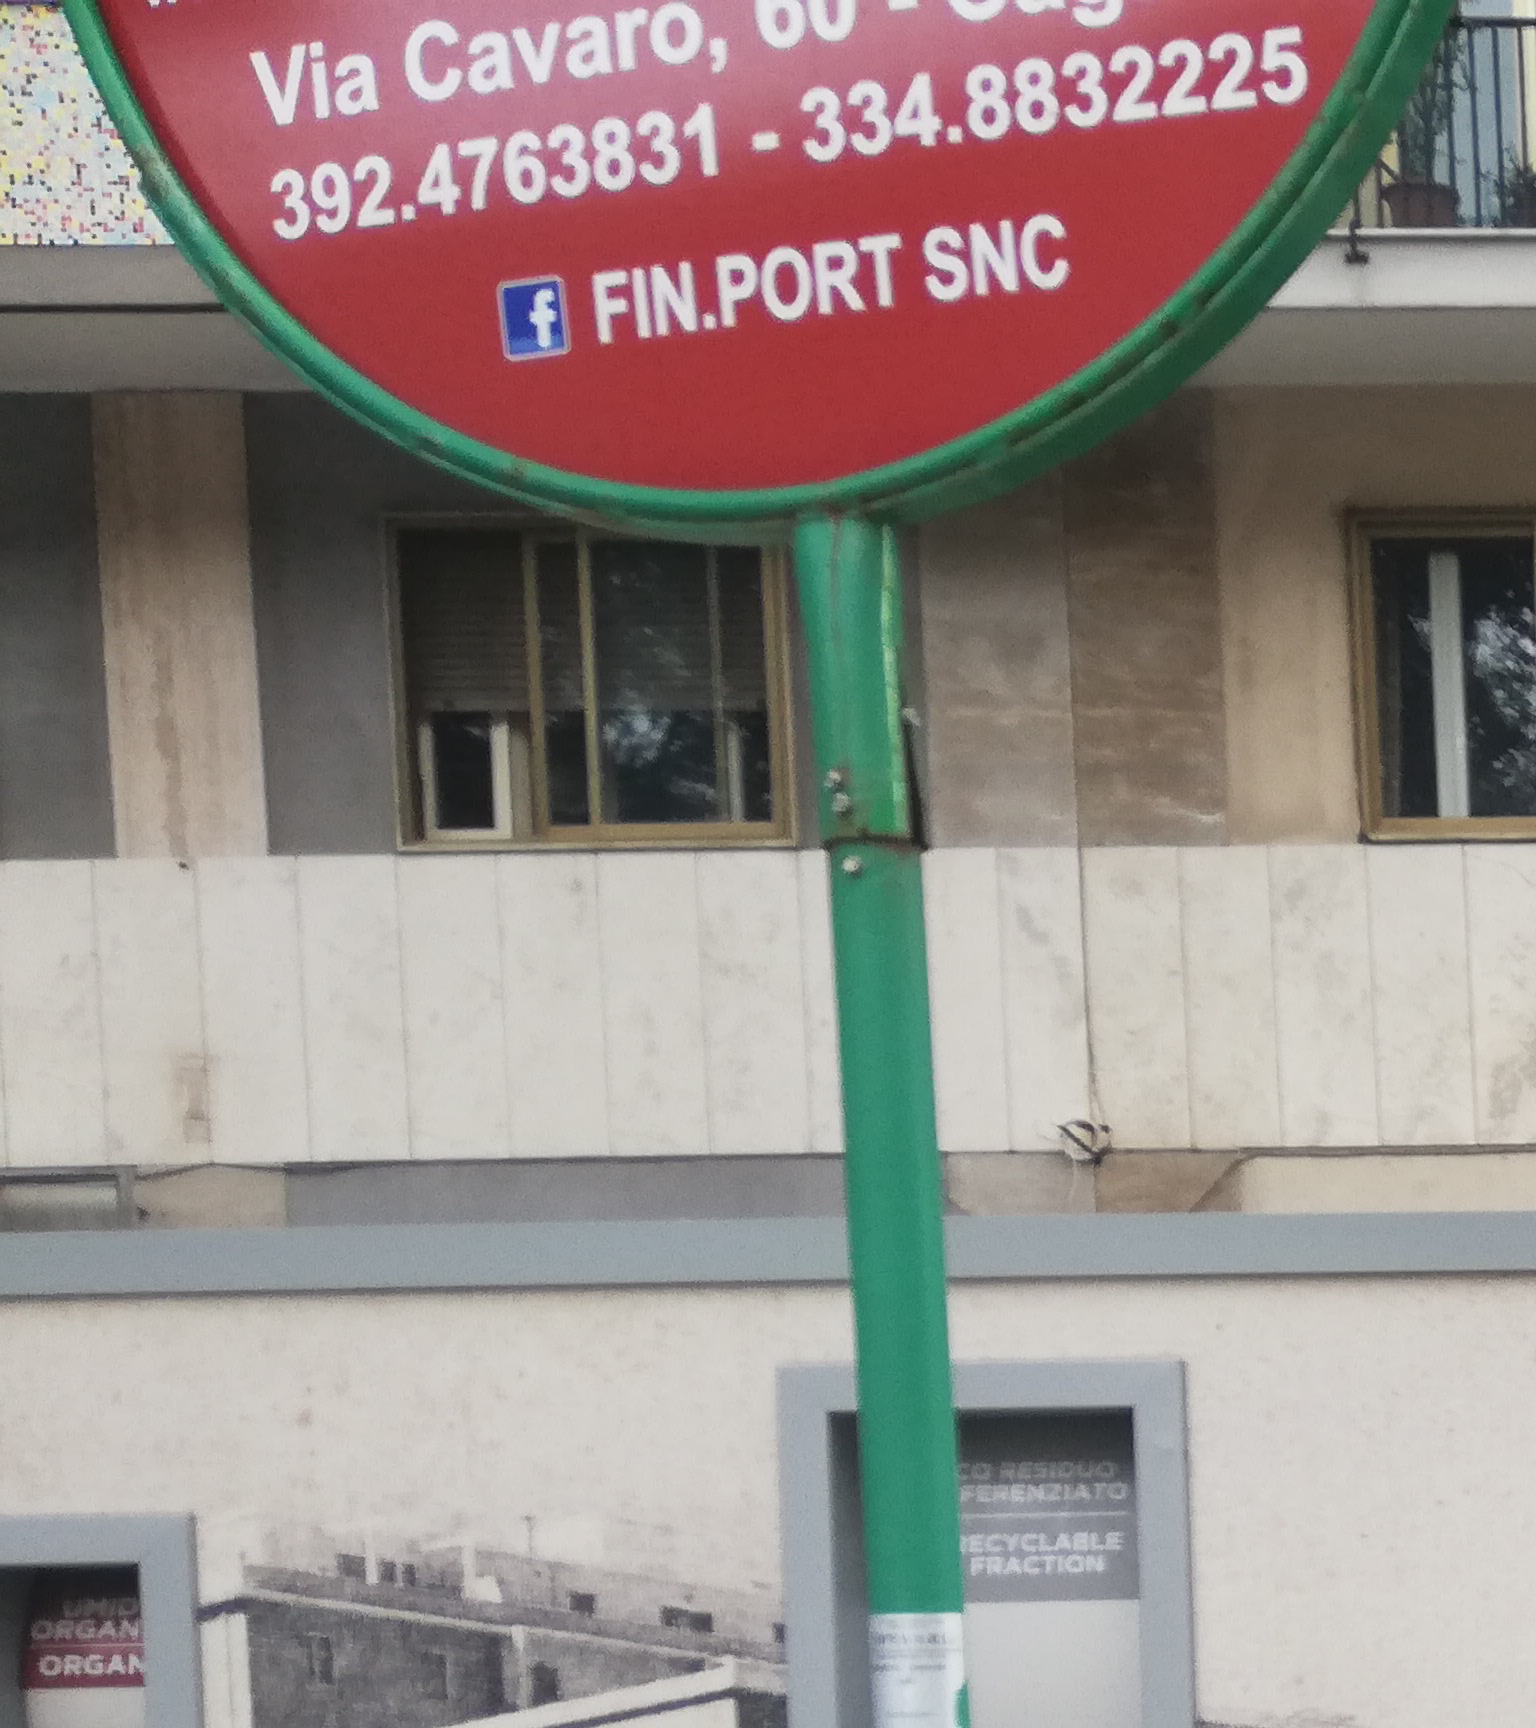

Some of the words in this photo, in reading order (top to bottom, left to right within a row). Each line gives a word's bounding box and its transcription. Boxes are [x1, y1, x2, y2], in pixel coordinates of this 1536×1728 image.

[250, 41, 380, 126] Via
[404, 2, 728, 102] Cavaro,
[270, 103, 720, 240] 392.4763831
[800, 26, 1308, 163] 334.8832225
[592, 232, 902, 344] FIN.PORT
[923, 213, 1070, 301] SNC
[960, 1481, 1129, 1502] FERENZIATO
[970, 1554, 1107, 1576] FRACTION
